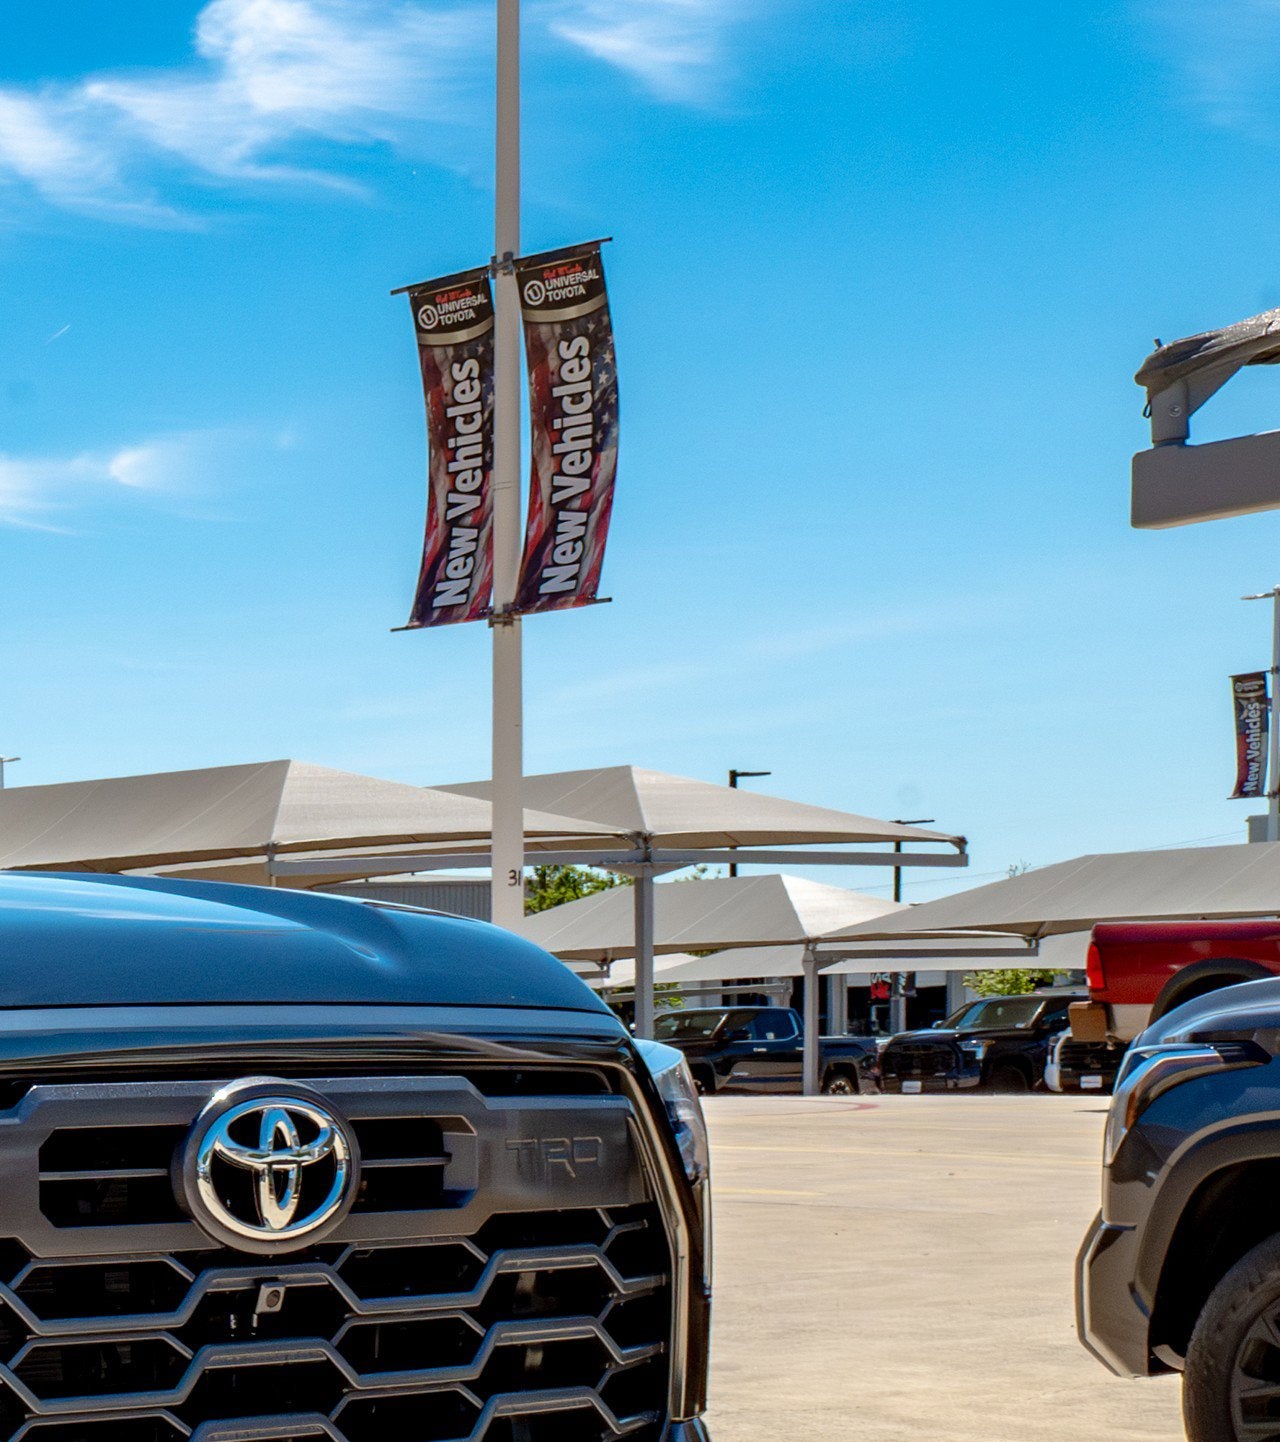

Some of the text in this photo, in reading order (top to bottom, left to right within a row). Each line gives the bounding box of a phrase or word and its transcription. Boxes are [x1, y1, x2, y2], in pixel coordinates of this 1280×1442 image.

[545, 269, 599, 290] UNIVERSAL
[437, 293, 488, 315] UNIVERSAL
[546, 284, 586, 302] TOYOTA
[439, 308, 475, 326] TOYOTA
[540, 336, 593, 595] New Vehicles
[432, 358, 483, 608] New Vehicles
[1245, 702, 1260, 760] Vehicles
[1243, 761, 1260, 792] New
[508, 869, 521, 886] 31
[506, 1136, 604, 1186] TRD
